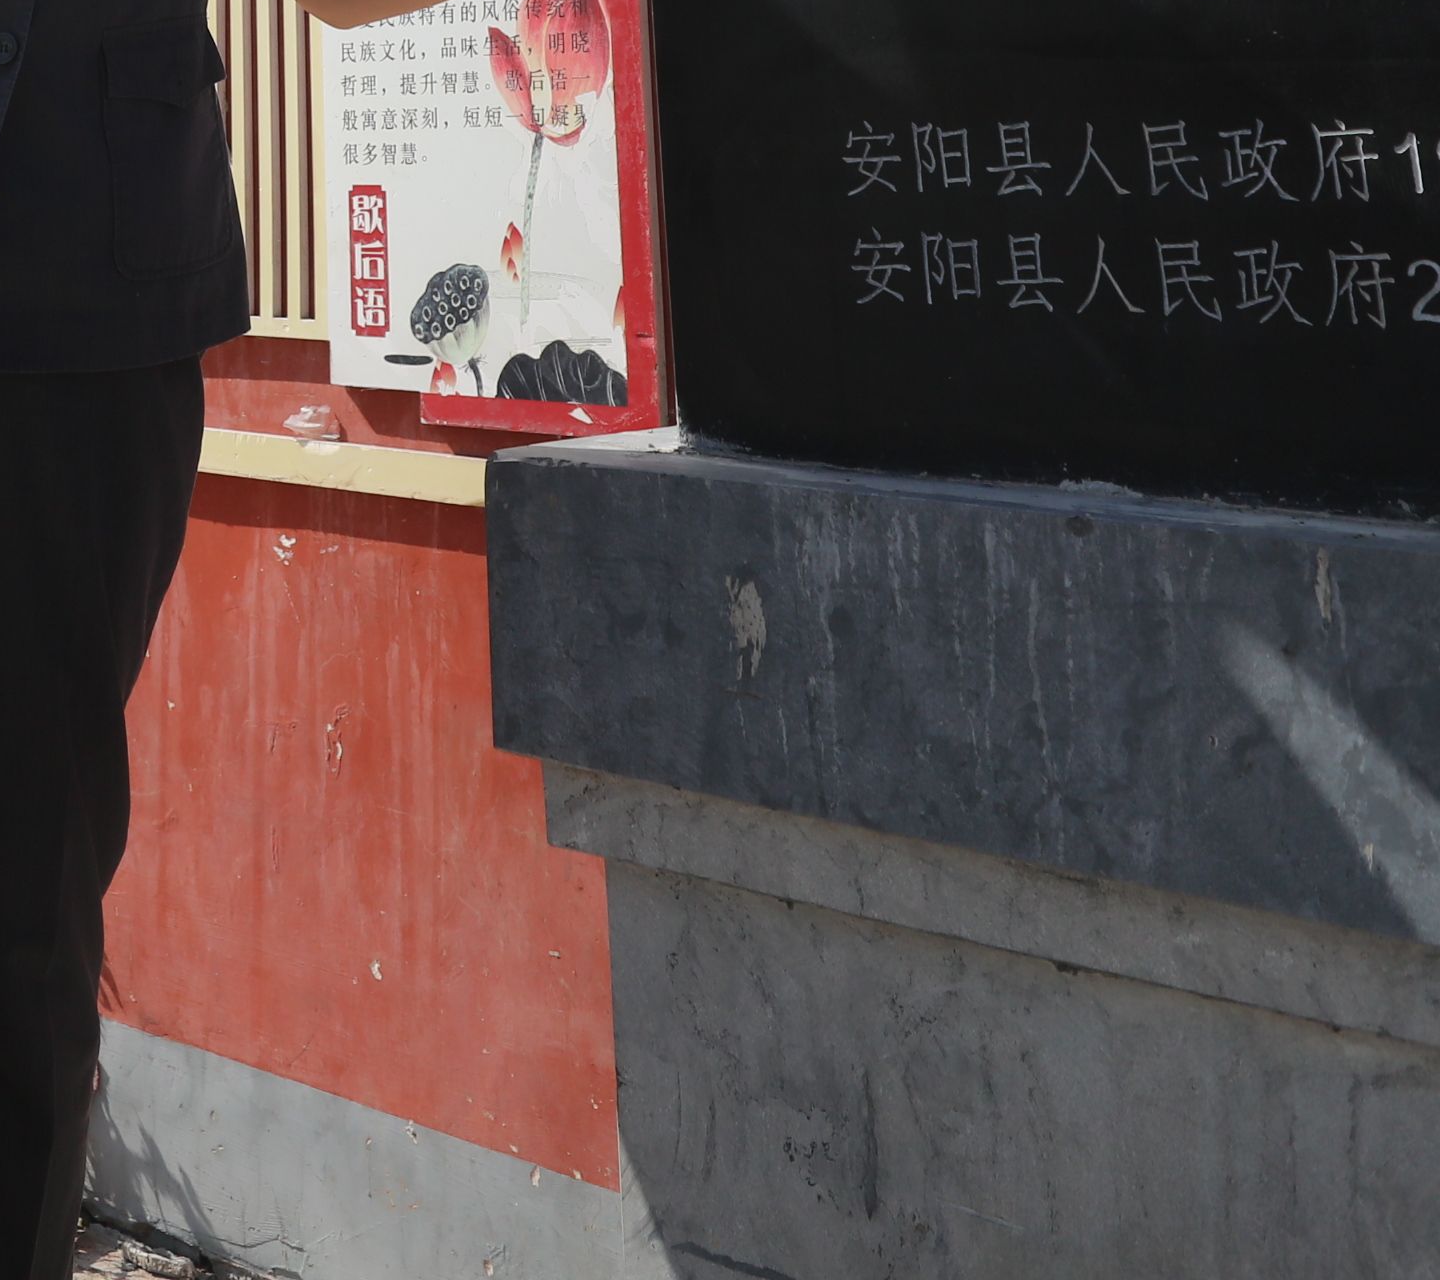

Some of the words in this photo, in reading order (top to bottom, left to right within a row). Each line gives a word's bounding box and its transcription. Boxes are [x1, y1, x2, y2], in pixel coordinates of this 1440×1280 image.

[340, 32, 591, 64] 民族文化，品味生活，明晓
[341, 70, 591, 97] 哲理，提升智慧。歇后语一
[342, 142, 429, 167] 很多智慧。
[351, 194, 388, 329] 歇后语
